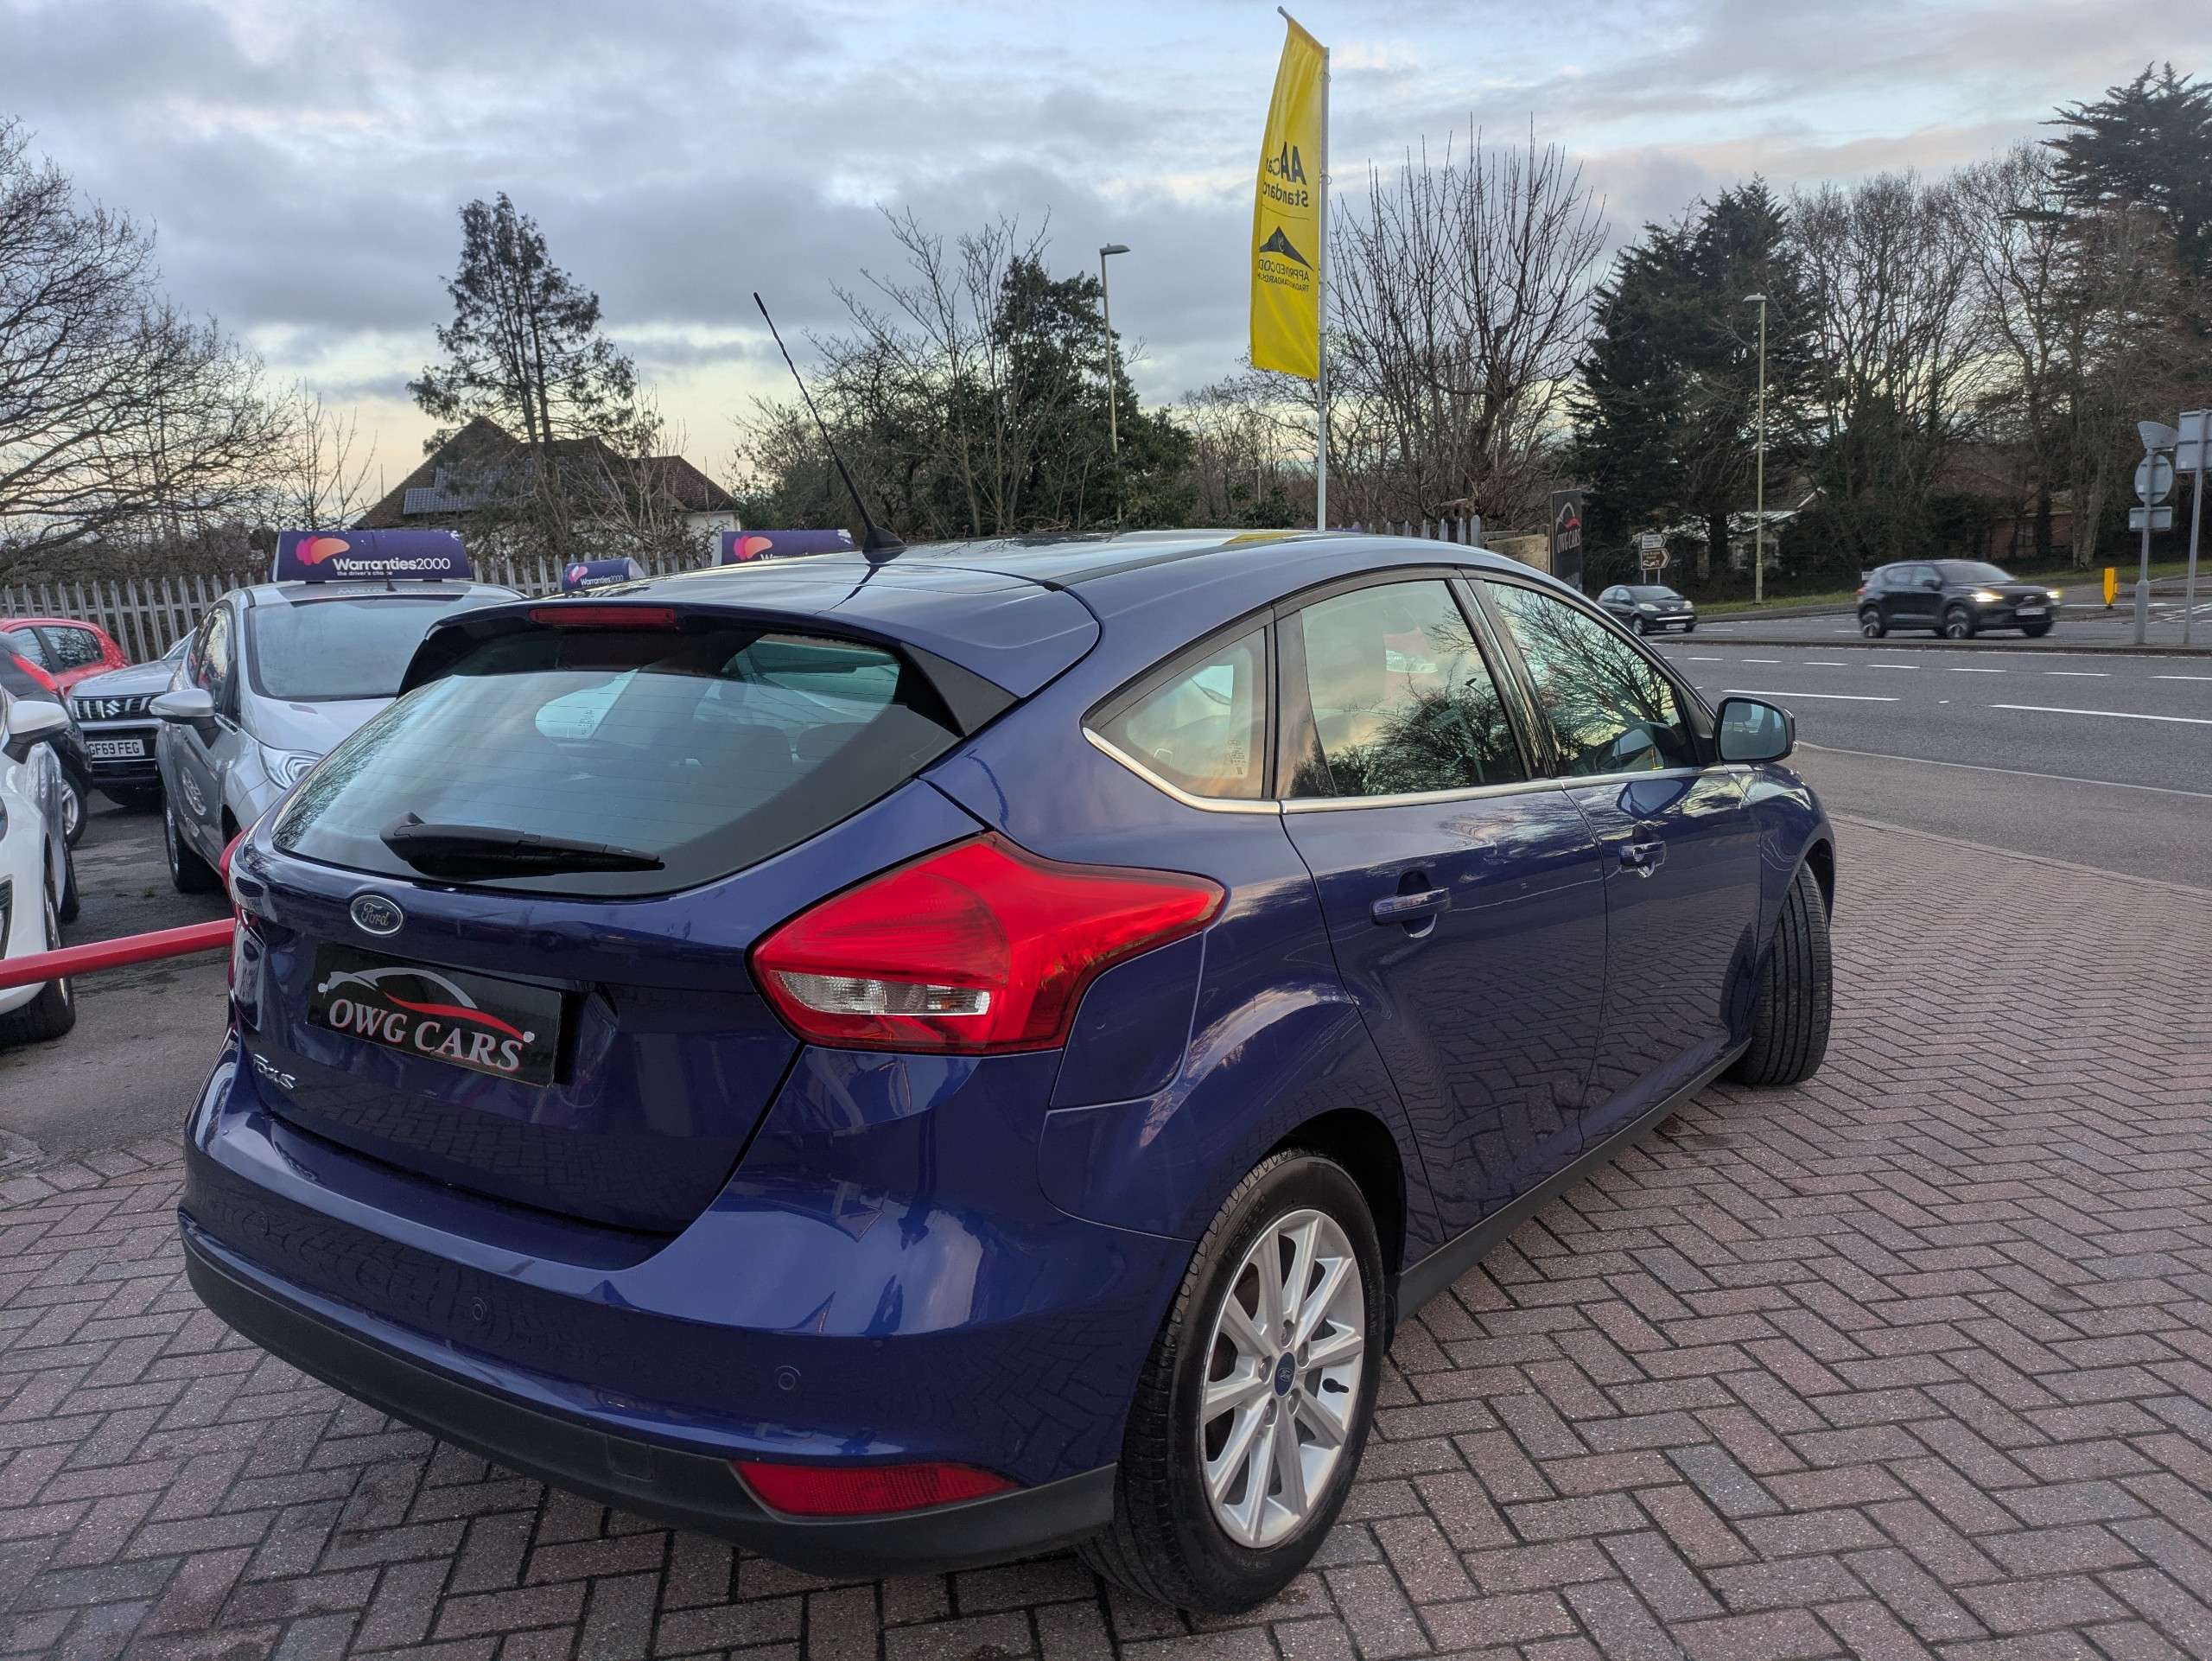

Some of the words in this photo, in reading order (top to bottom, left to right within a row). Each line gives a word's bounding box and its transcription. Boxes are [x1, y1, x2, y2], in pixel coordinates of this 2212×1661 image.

[332, 557, 451, 571] Warranties2000
[89, 742, 116, 755] GF69
[118, 741, 140, 754] FEG
[360, 903, 389, 926] Ford
[328, 998, 408, 1044] OWG
[415, 1021, 524, 1072] CARS
